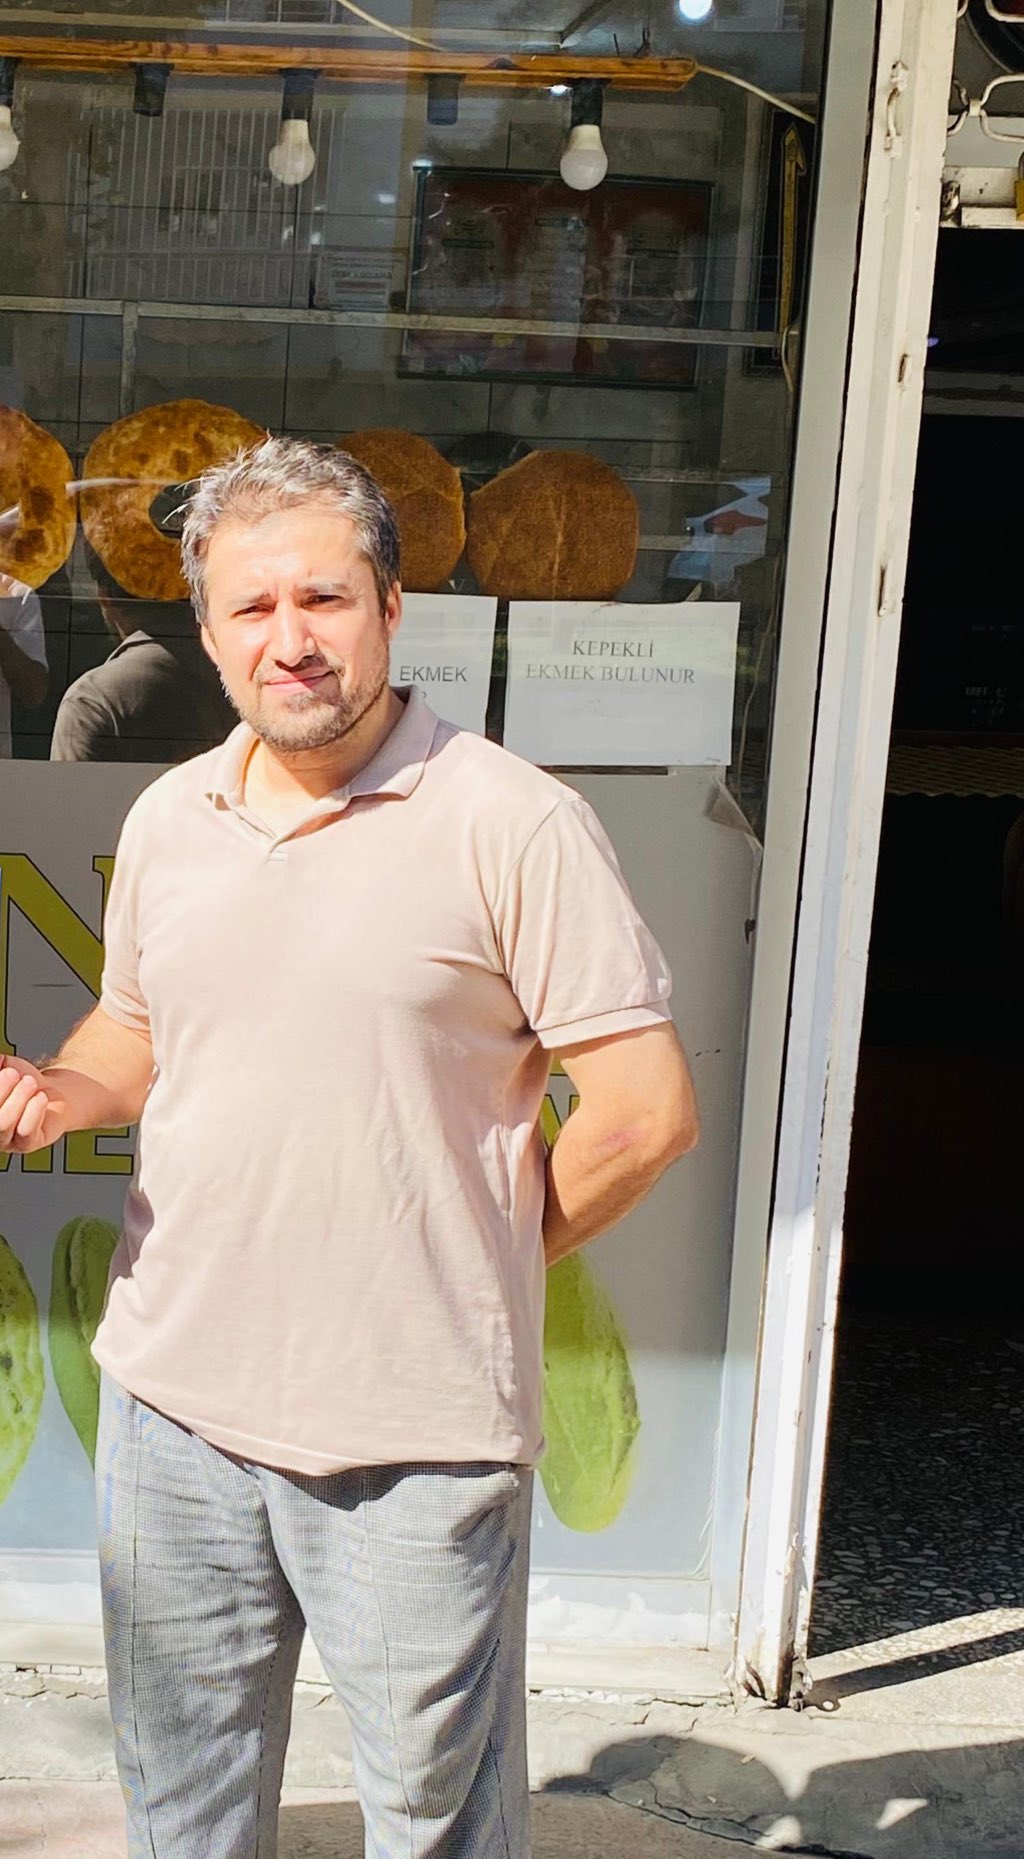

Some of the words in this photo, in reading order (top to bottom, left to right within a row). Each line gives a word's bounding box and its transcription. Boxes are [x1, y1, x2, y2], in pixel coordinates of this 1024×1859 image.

[573, 640, 653, 657] KEPEKLİ
[400, 665, 467, 682] EKMEK
[526, 663, 594, 681] EKMEK
[601, 666, 695, 684] BULUNUR
